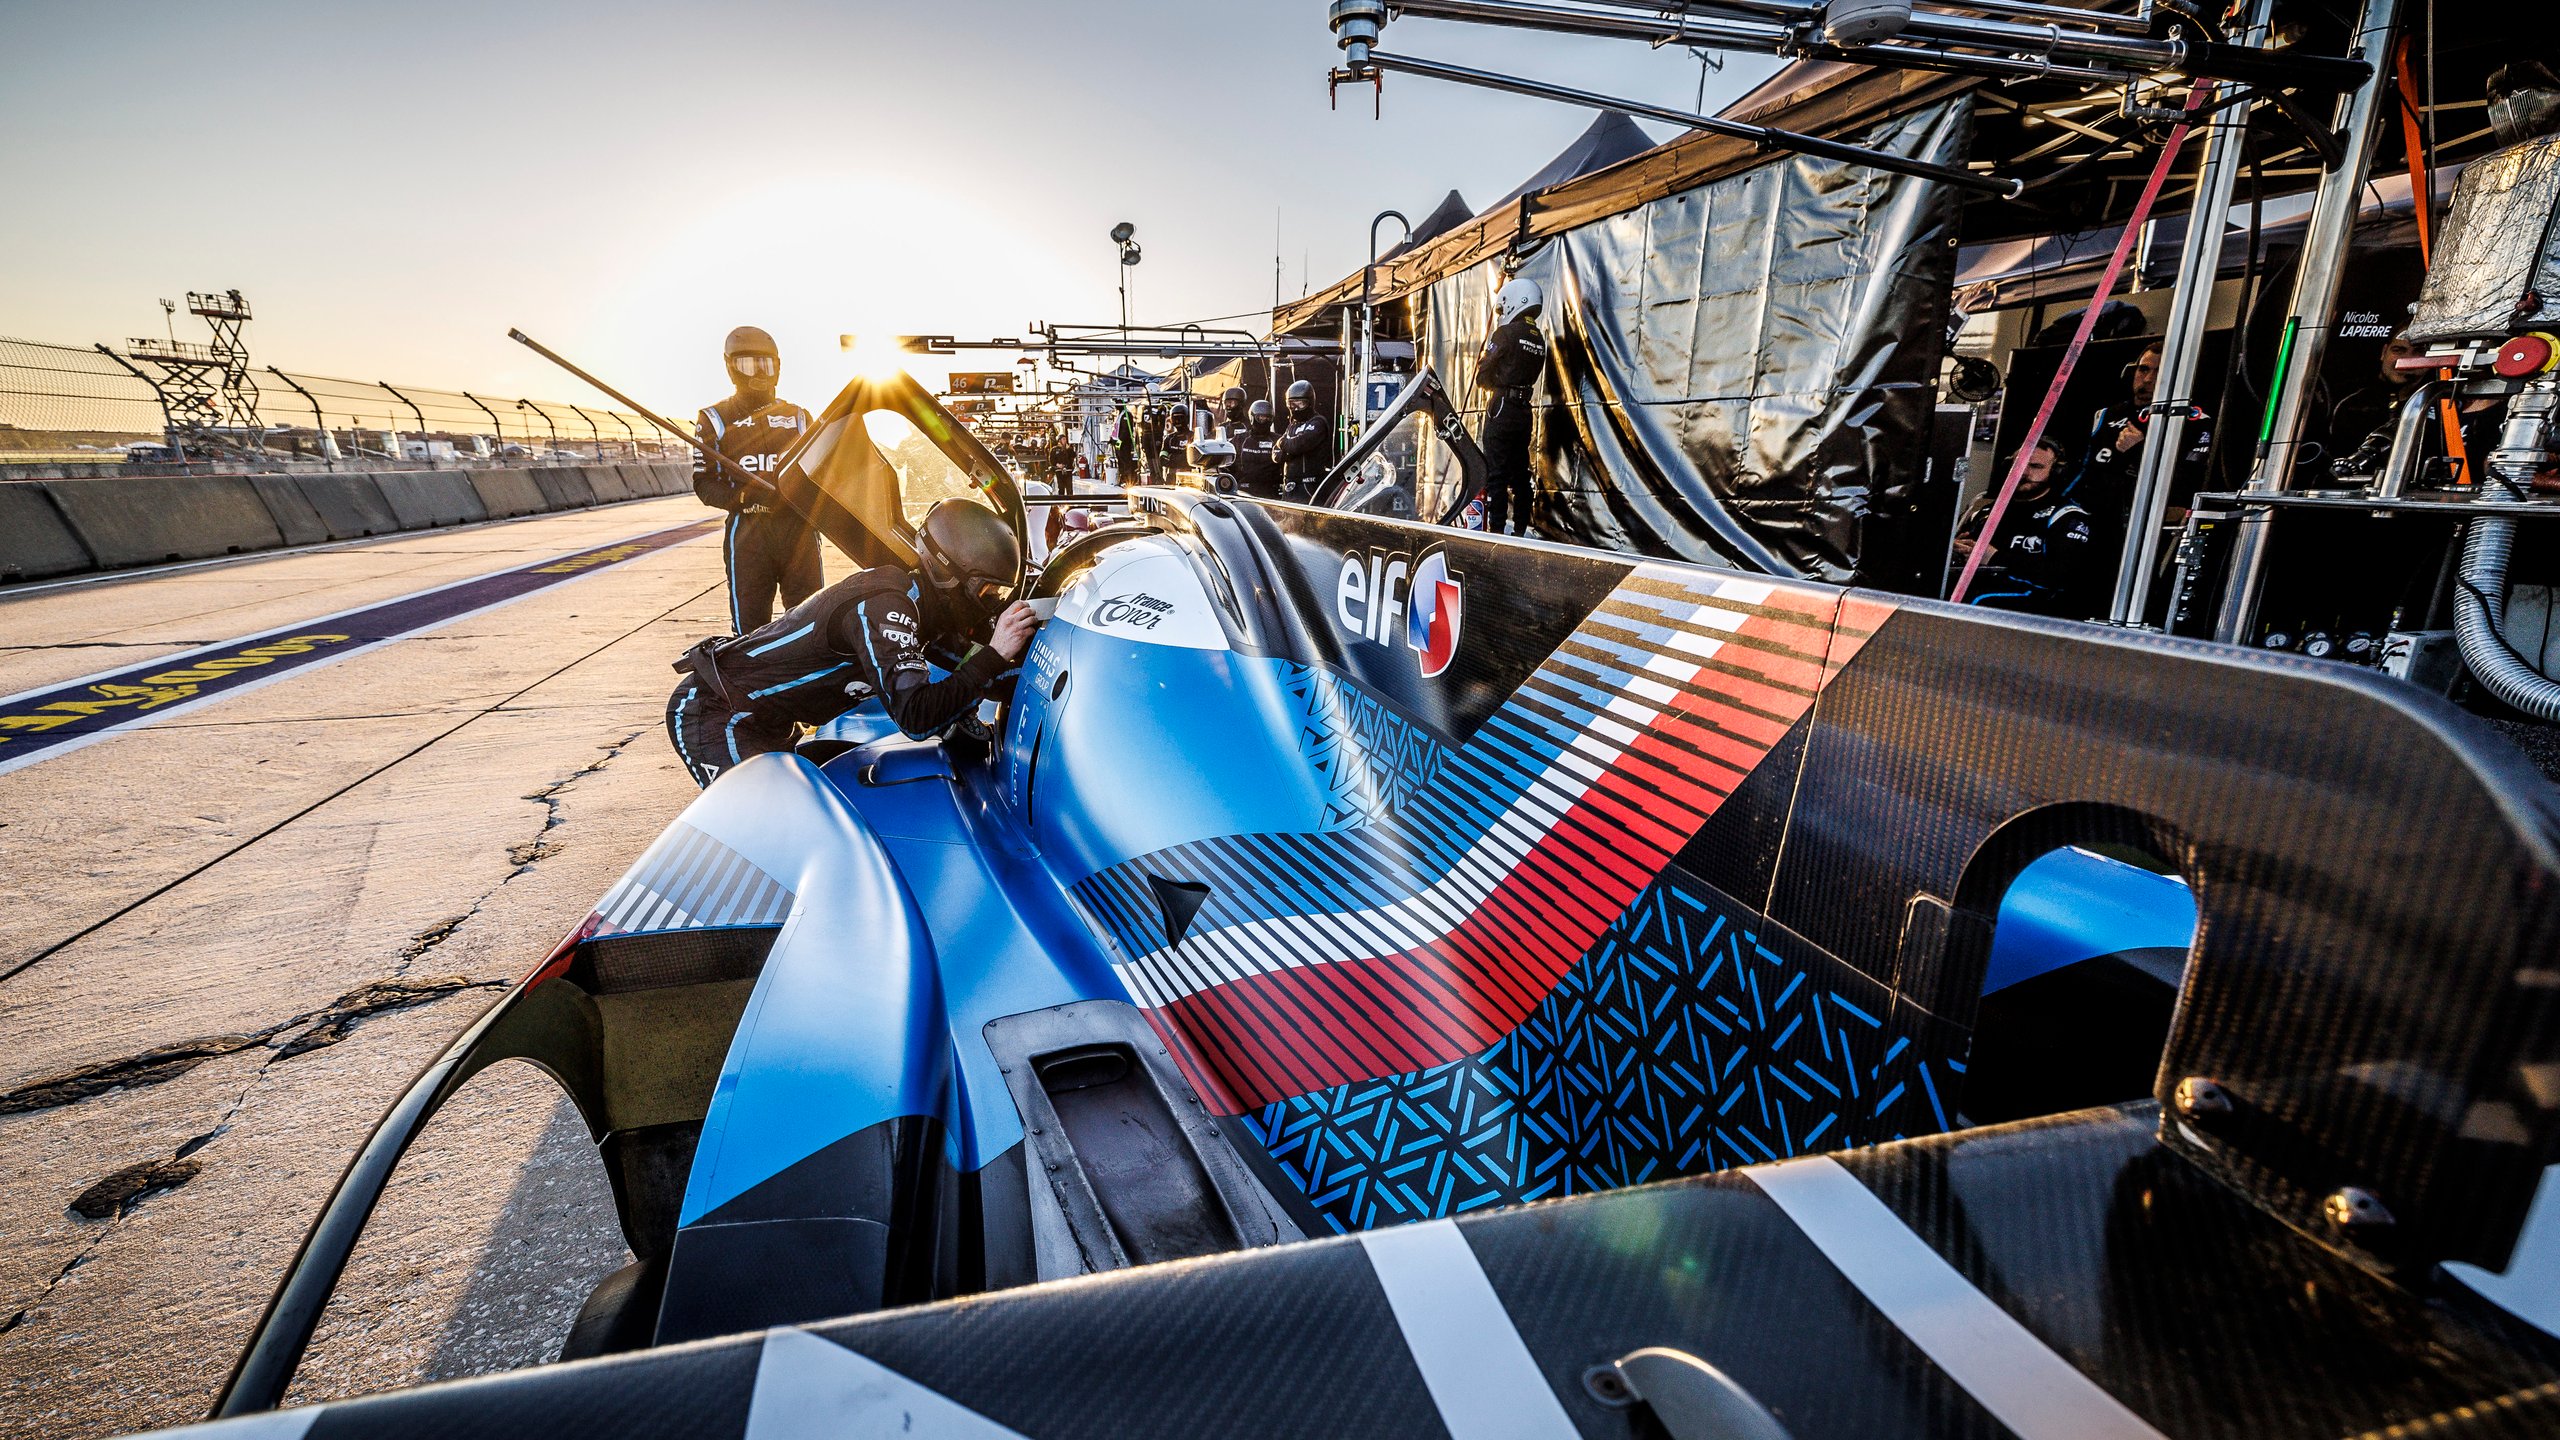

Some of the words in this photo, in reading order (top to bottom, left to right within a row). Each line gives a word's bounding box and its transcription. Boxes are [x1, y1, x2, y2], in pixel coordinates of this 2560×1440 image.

[2343, 311, 2380, 323] Nicolas
[2339, 325, 2393, 337] LAPIERRE
[952, 377, 967, 389] 46
[1374, 385, 1387, 409] 1
[739, 453, 778, 472] elf
[1138, 495, 1167, 515] PINE
[1129, 592, 1174, 613] France
[1337, 555, 1408, 648] elf
[886, 611, 912, 627] elf
[1088, 594, 1163, 630] Toner
[0, 634, 351, 742] GOODYE
[1035, 672, 1050, 691] GROUP
